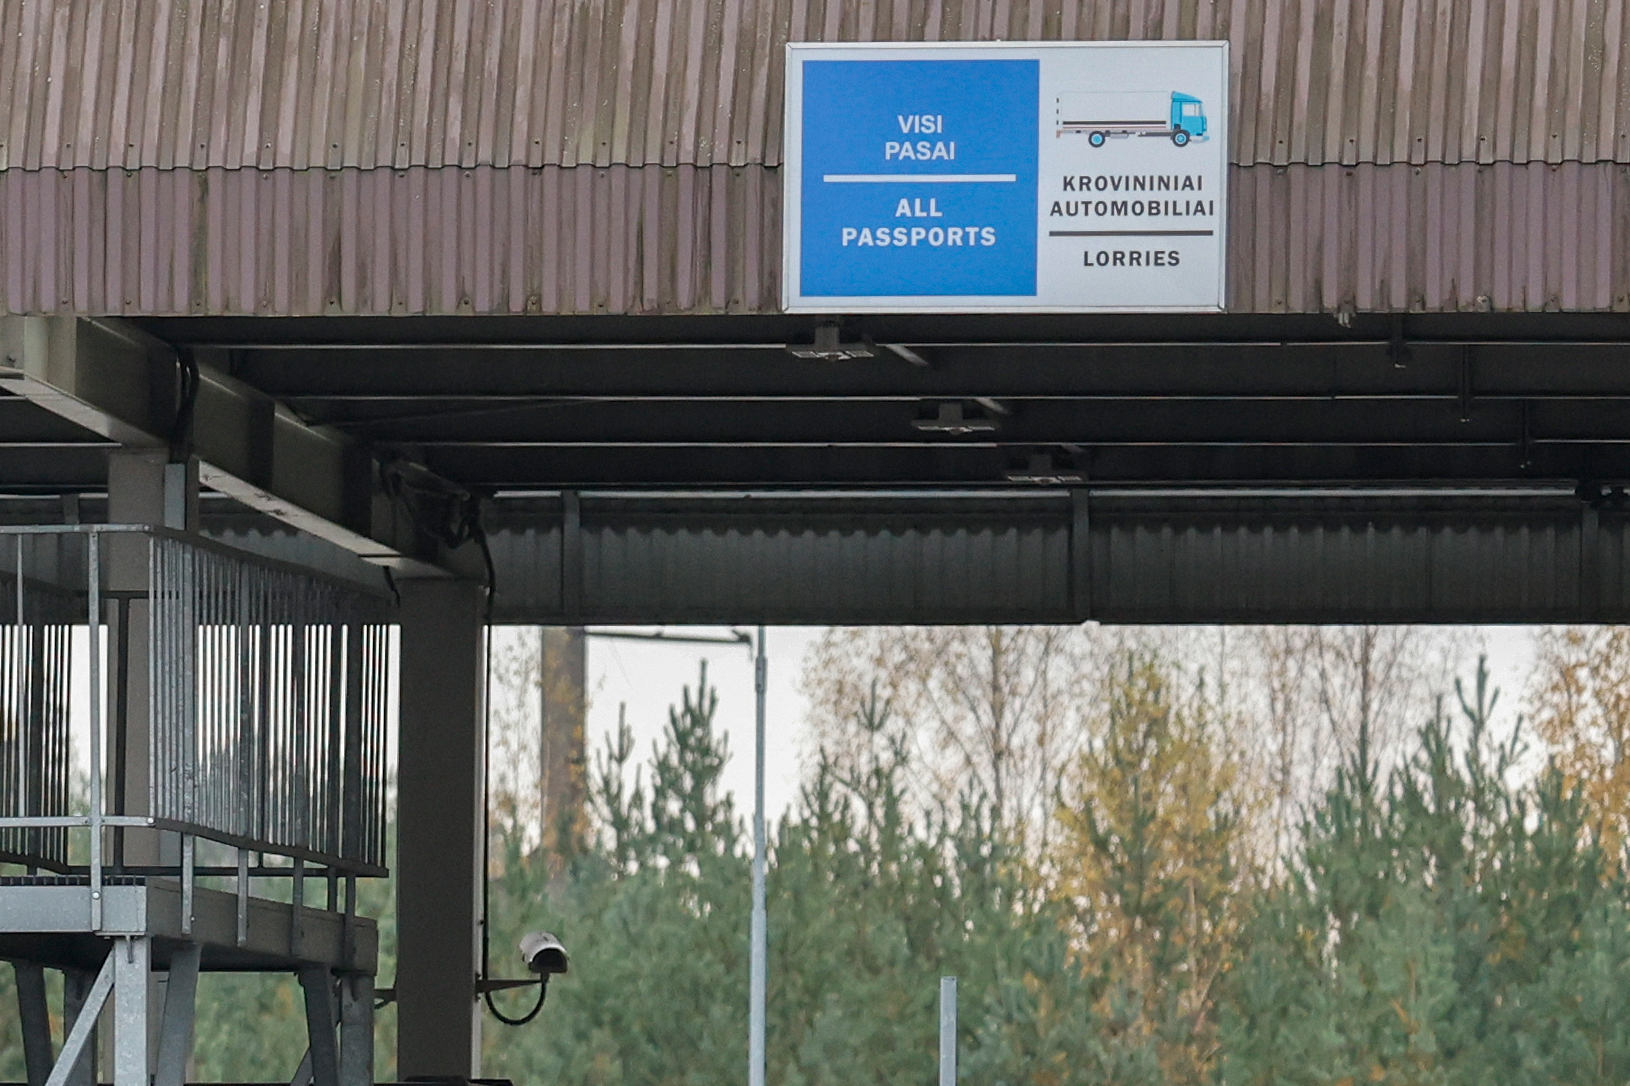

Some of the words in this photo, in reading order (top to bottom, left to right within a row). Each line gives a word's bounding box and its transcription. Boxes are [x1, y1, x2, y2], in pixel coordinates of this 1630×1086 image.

[897, 114, 943, 134] VISI
[885, 141, 955, 161] PASAI
[1062, 175, 1204, 193] KROVININIAI
[895, 197, 943, 218] ALL
[1049, 199, 1216, 218] AUTOMOBILIAI
[842, 226, 996, 247] PASSPORTS
[1083, 250, 1182, 268] LORRIES
